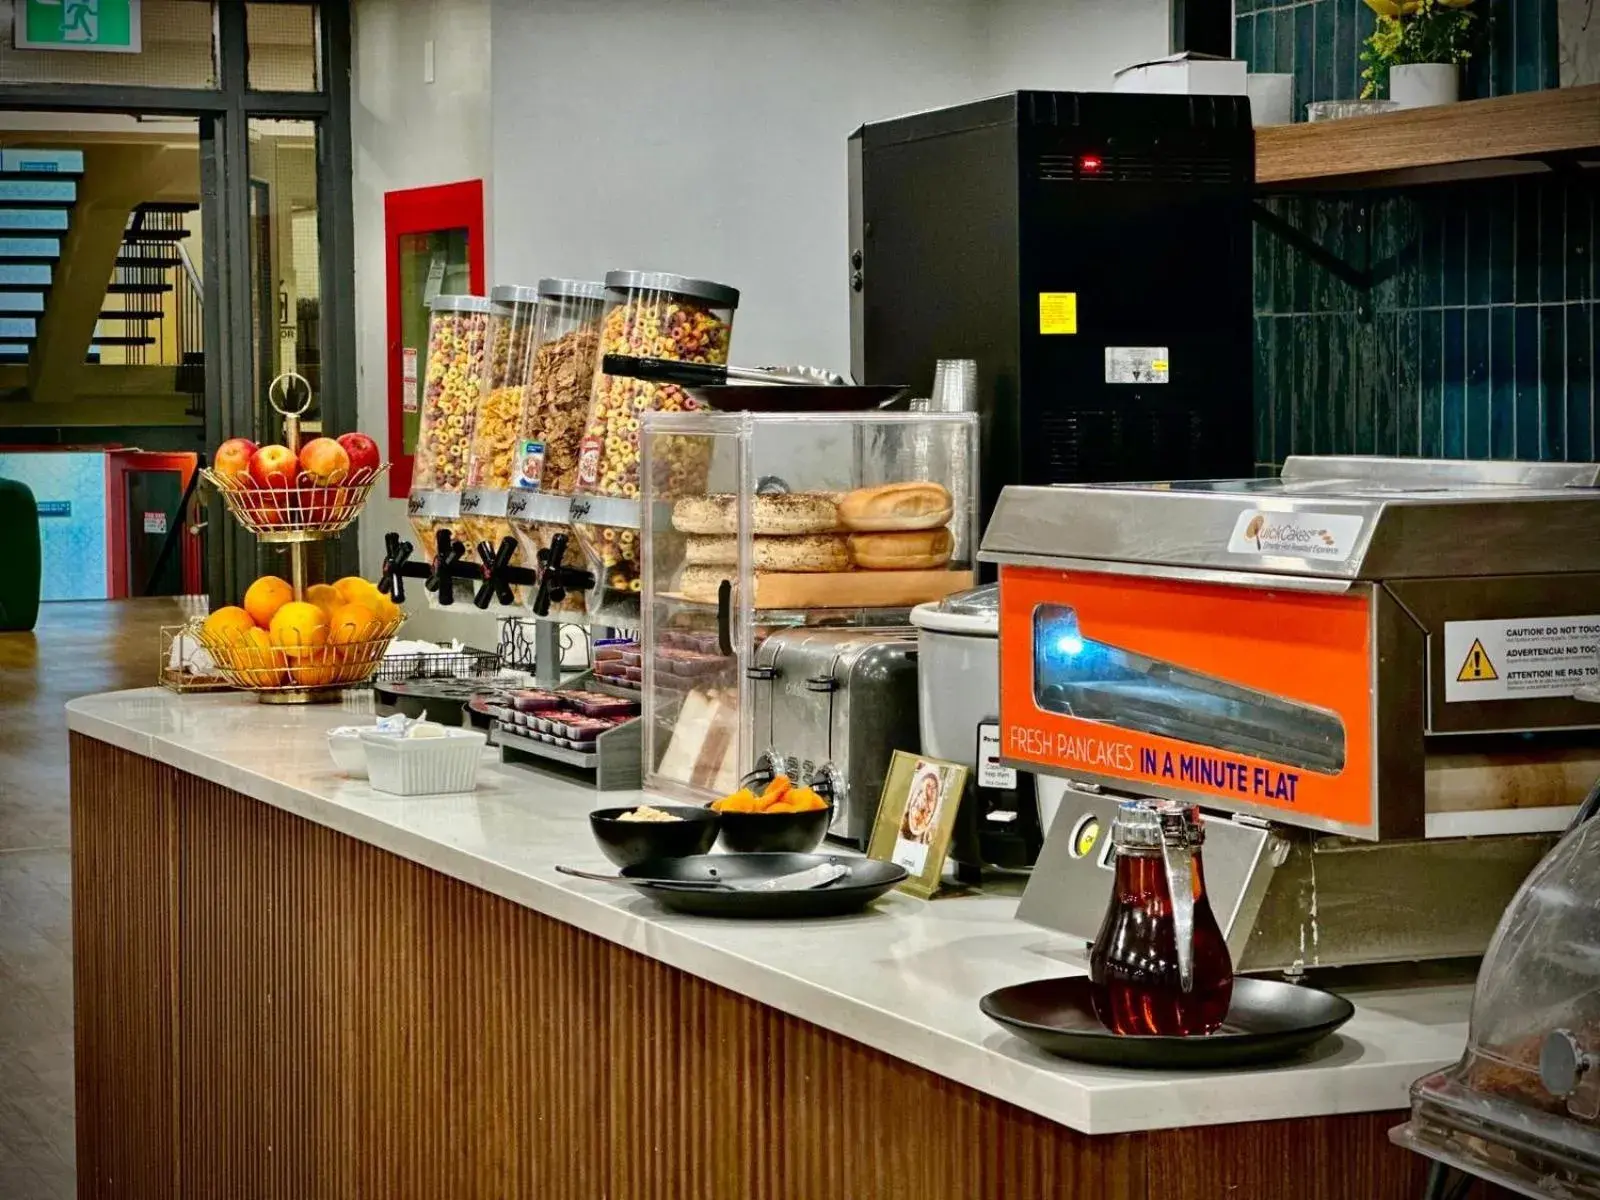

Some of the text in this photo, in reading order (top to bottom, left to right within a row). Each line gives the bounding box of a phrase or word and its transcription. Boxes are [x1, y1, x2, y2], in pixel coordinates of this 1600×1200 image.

[1506, 628, 1544, 637] CAUTION!
[1546, 627, 1558, 635] DO
[1560, 626, 1577, 634] NOT
[1506, 648, 1564, 657] ADVERTENCIA!
[1566, 646, 1578, 654] NO
[1507, 670, 1553, 679] ATTENTION!
[1568, 668, 1584, 676] PAS
[1009, 725, 1298, 802] FRESH PANCAKES IN A MINUTE FLAT
